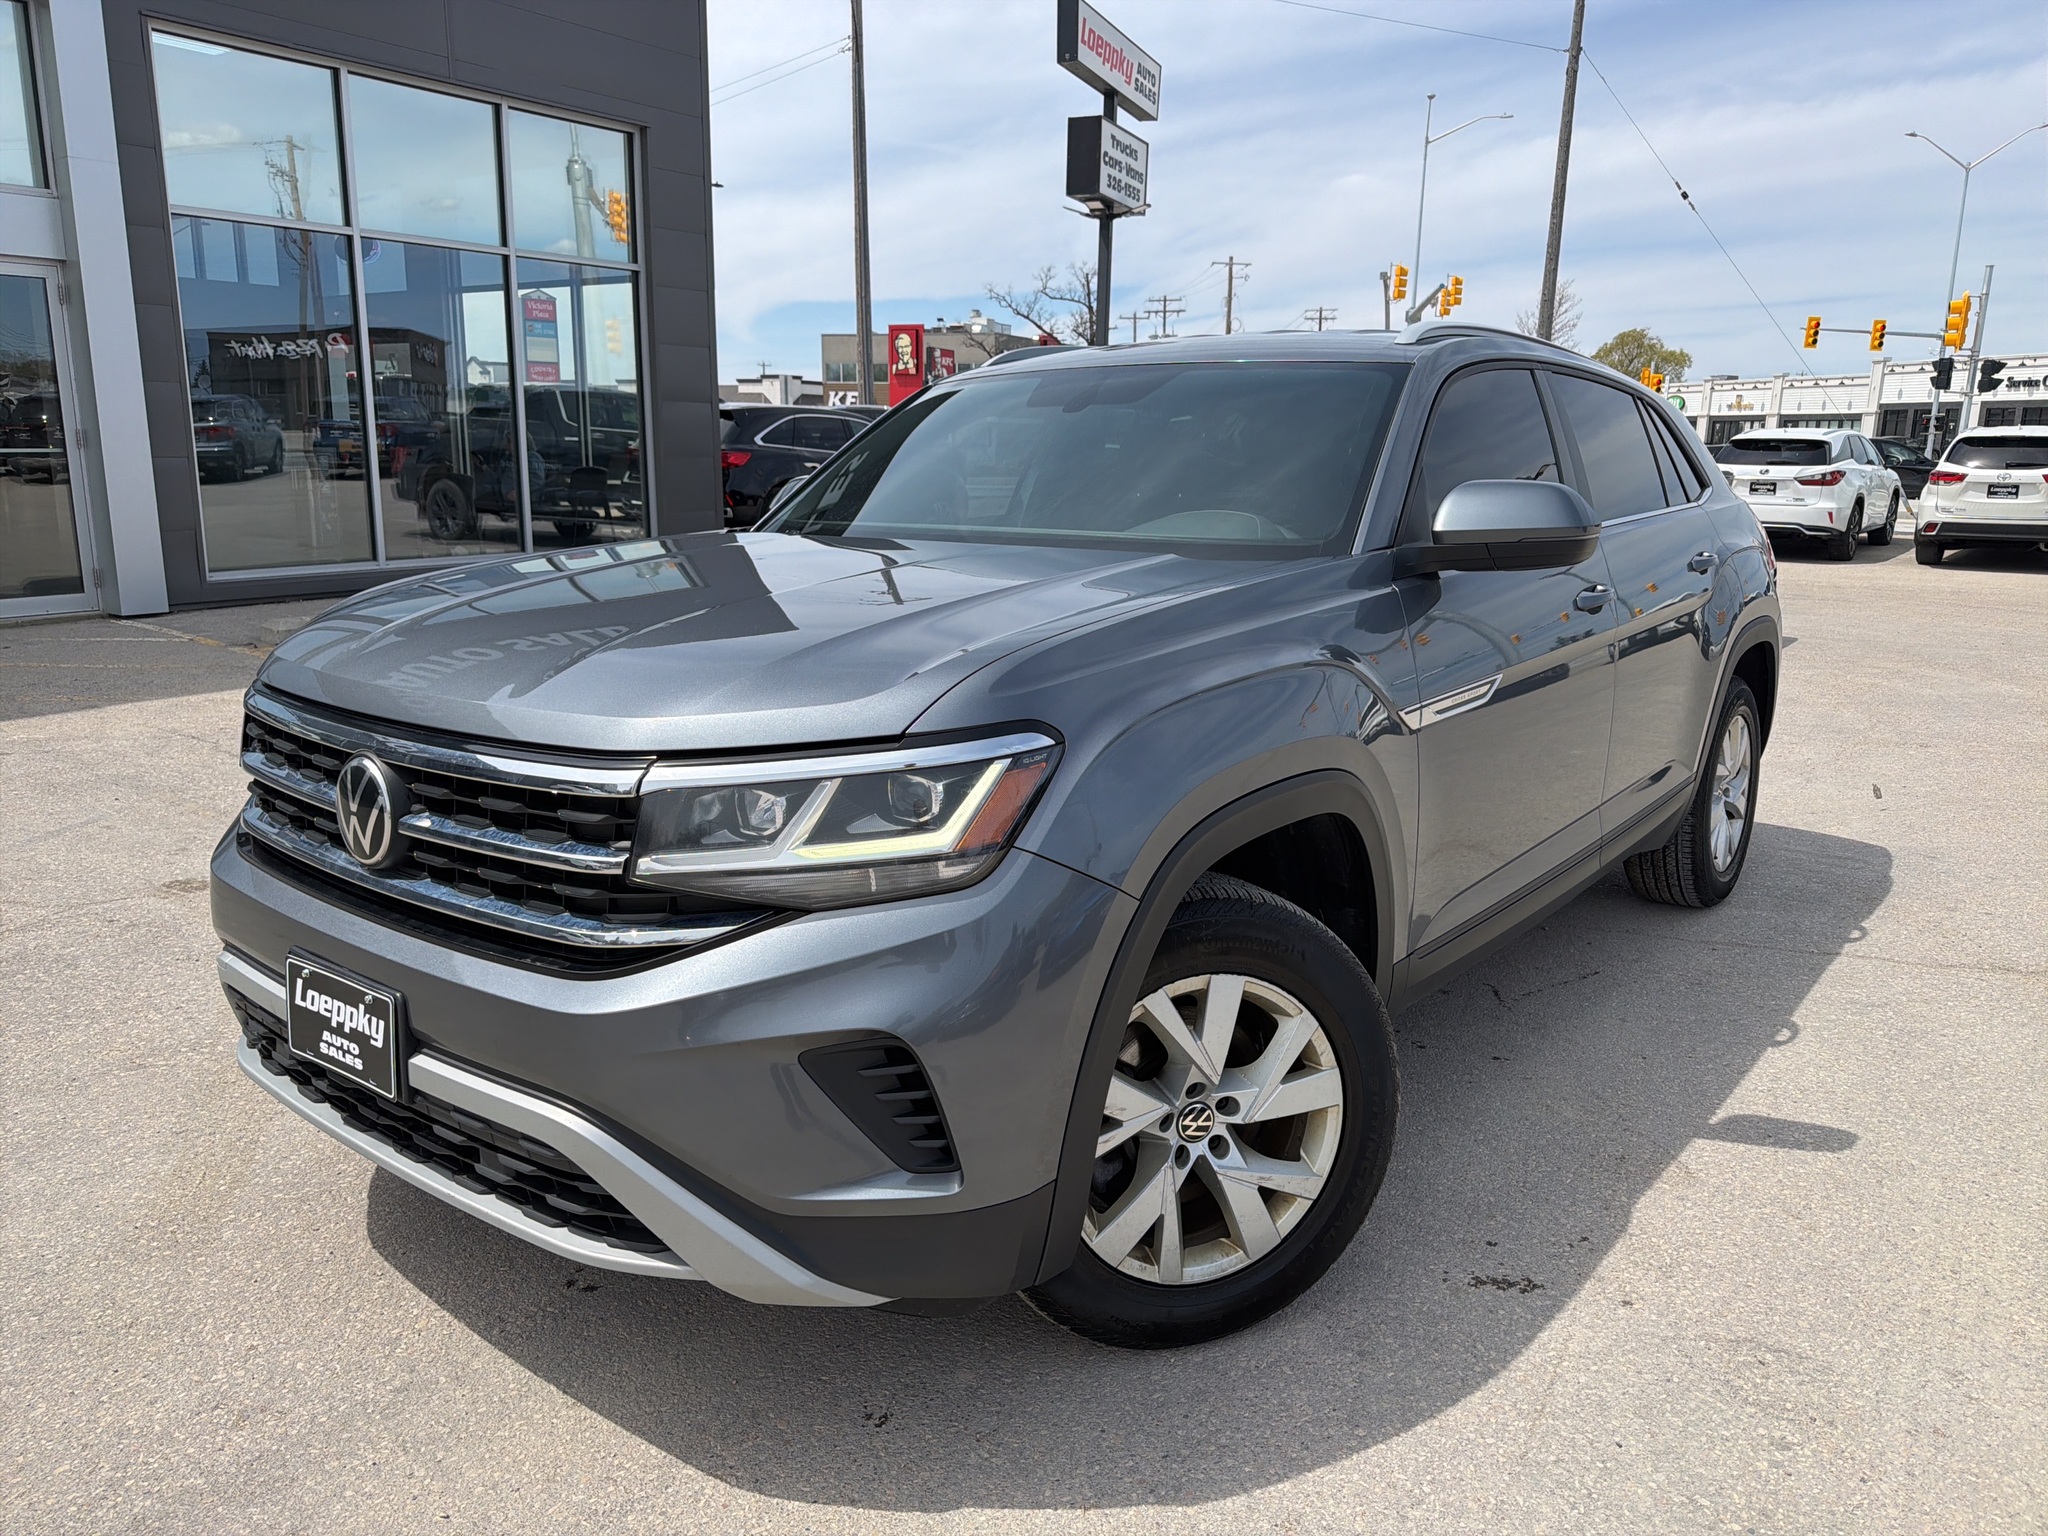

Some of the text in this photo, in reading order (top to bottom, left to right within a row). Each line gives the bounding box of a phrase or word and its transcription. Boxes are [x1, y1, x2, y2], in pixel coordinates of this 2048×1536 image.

[1080, 17, 1134, 86] Loeppky
[1136, 61, 1156, 88] AUTO
[1134, 77, 1157, 105] SALES
[1110, 133, 1139, 162] Trucks
[1106, 173, 1141, 202] 326-1555
[941, 357, 954, 367] KFC
[2005, 376, 2041, 389] Service
[294, 977, 385, 1049] Loeppky
[319, 1042, 363, 1071] SALES
[321, 1030, 360, 1056] AUTO
